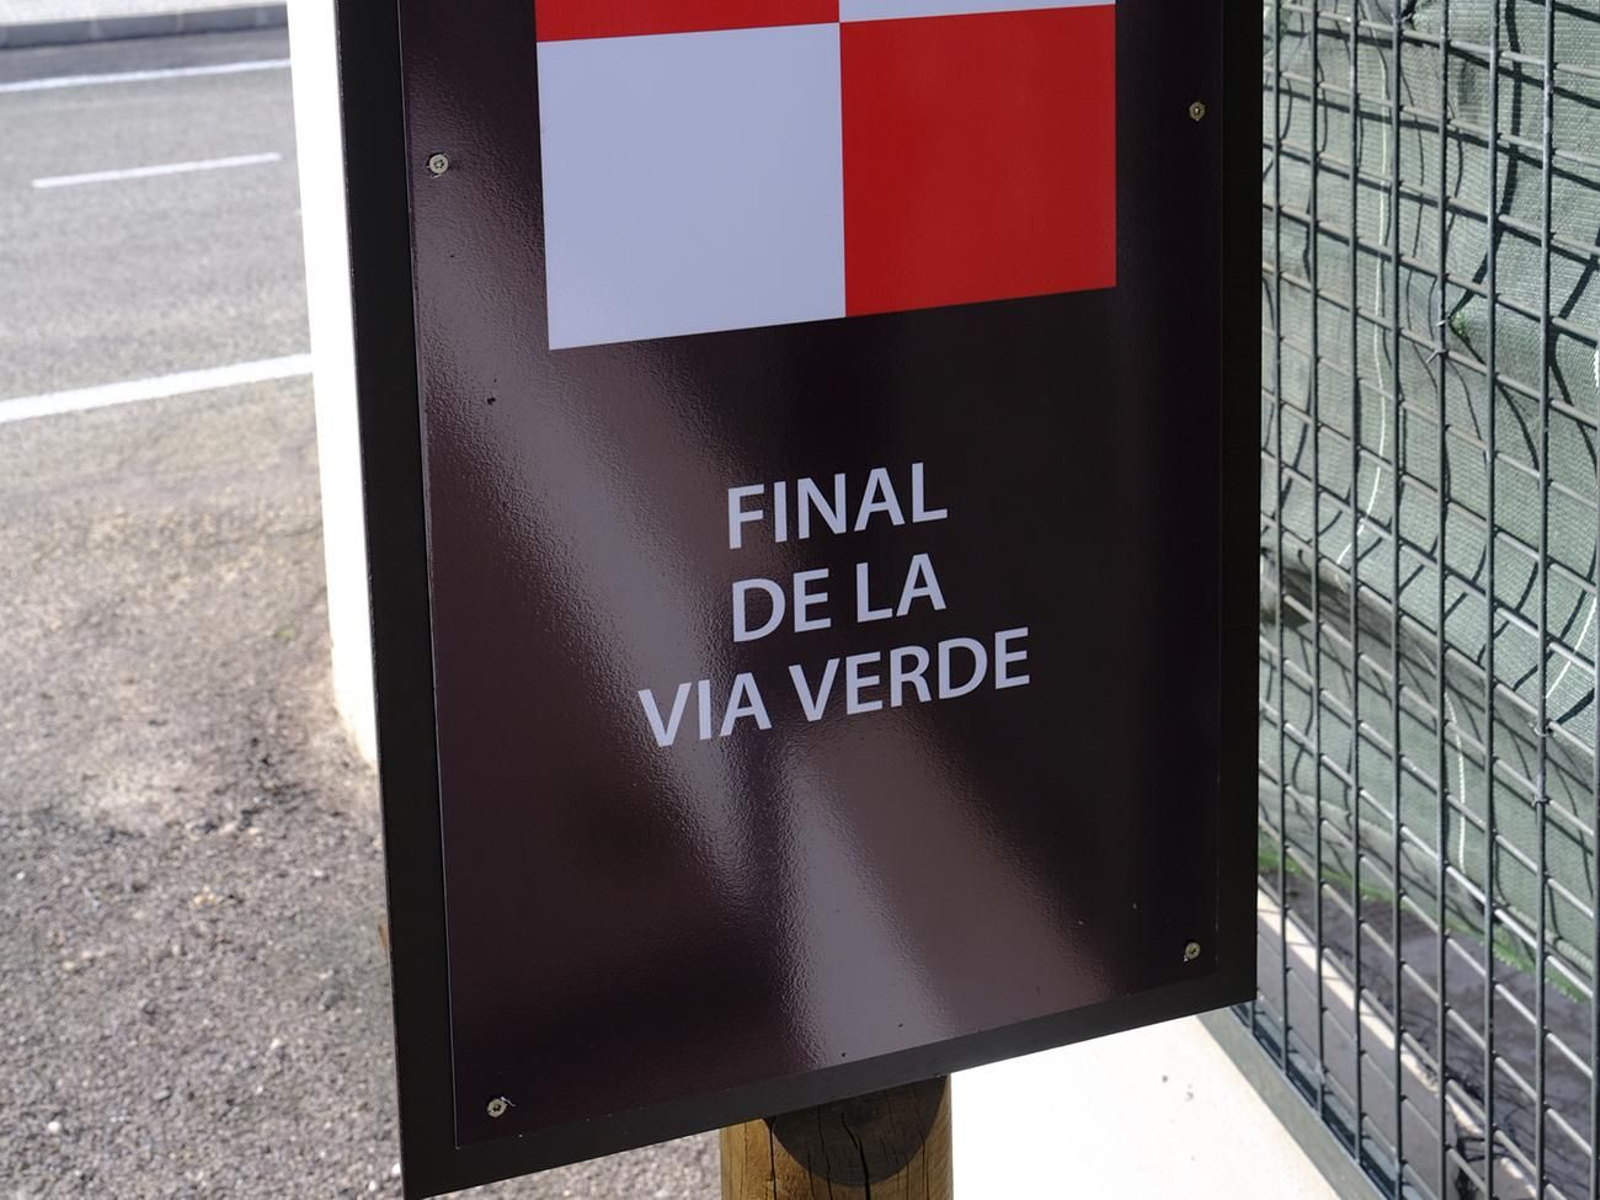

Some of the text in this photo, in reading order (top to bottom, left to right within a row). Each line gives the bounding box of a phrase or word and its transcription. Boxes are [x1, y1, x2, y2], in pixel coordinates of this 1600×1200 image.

[727, 462, 948, 549] FINAL
[732, 553, 946, 642] DE LA
[637, 627, 1030, 748] VIA VERDE
